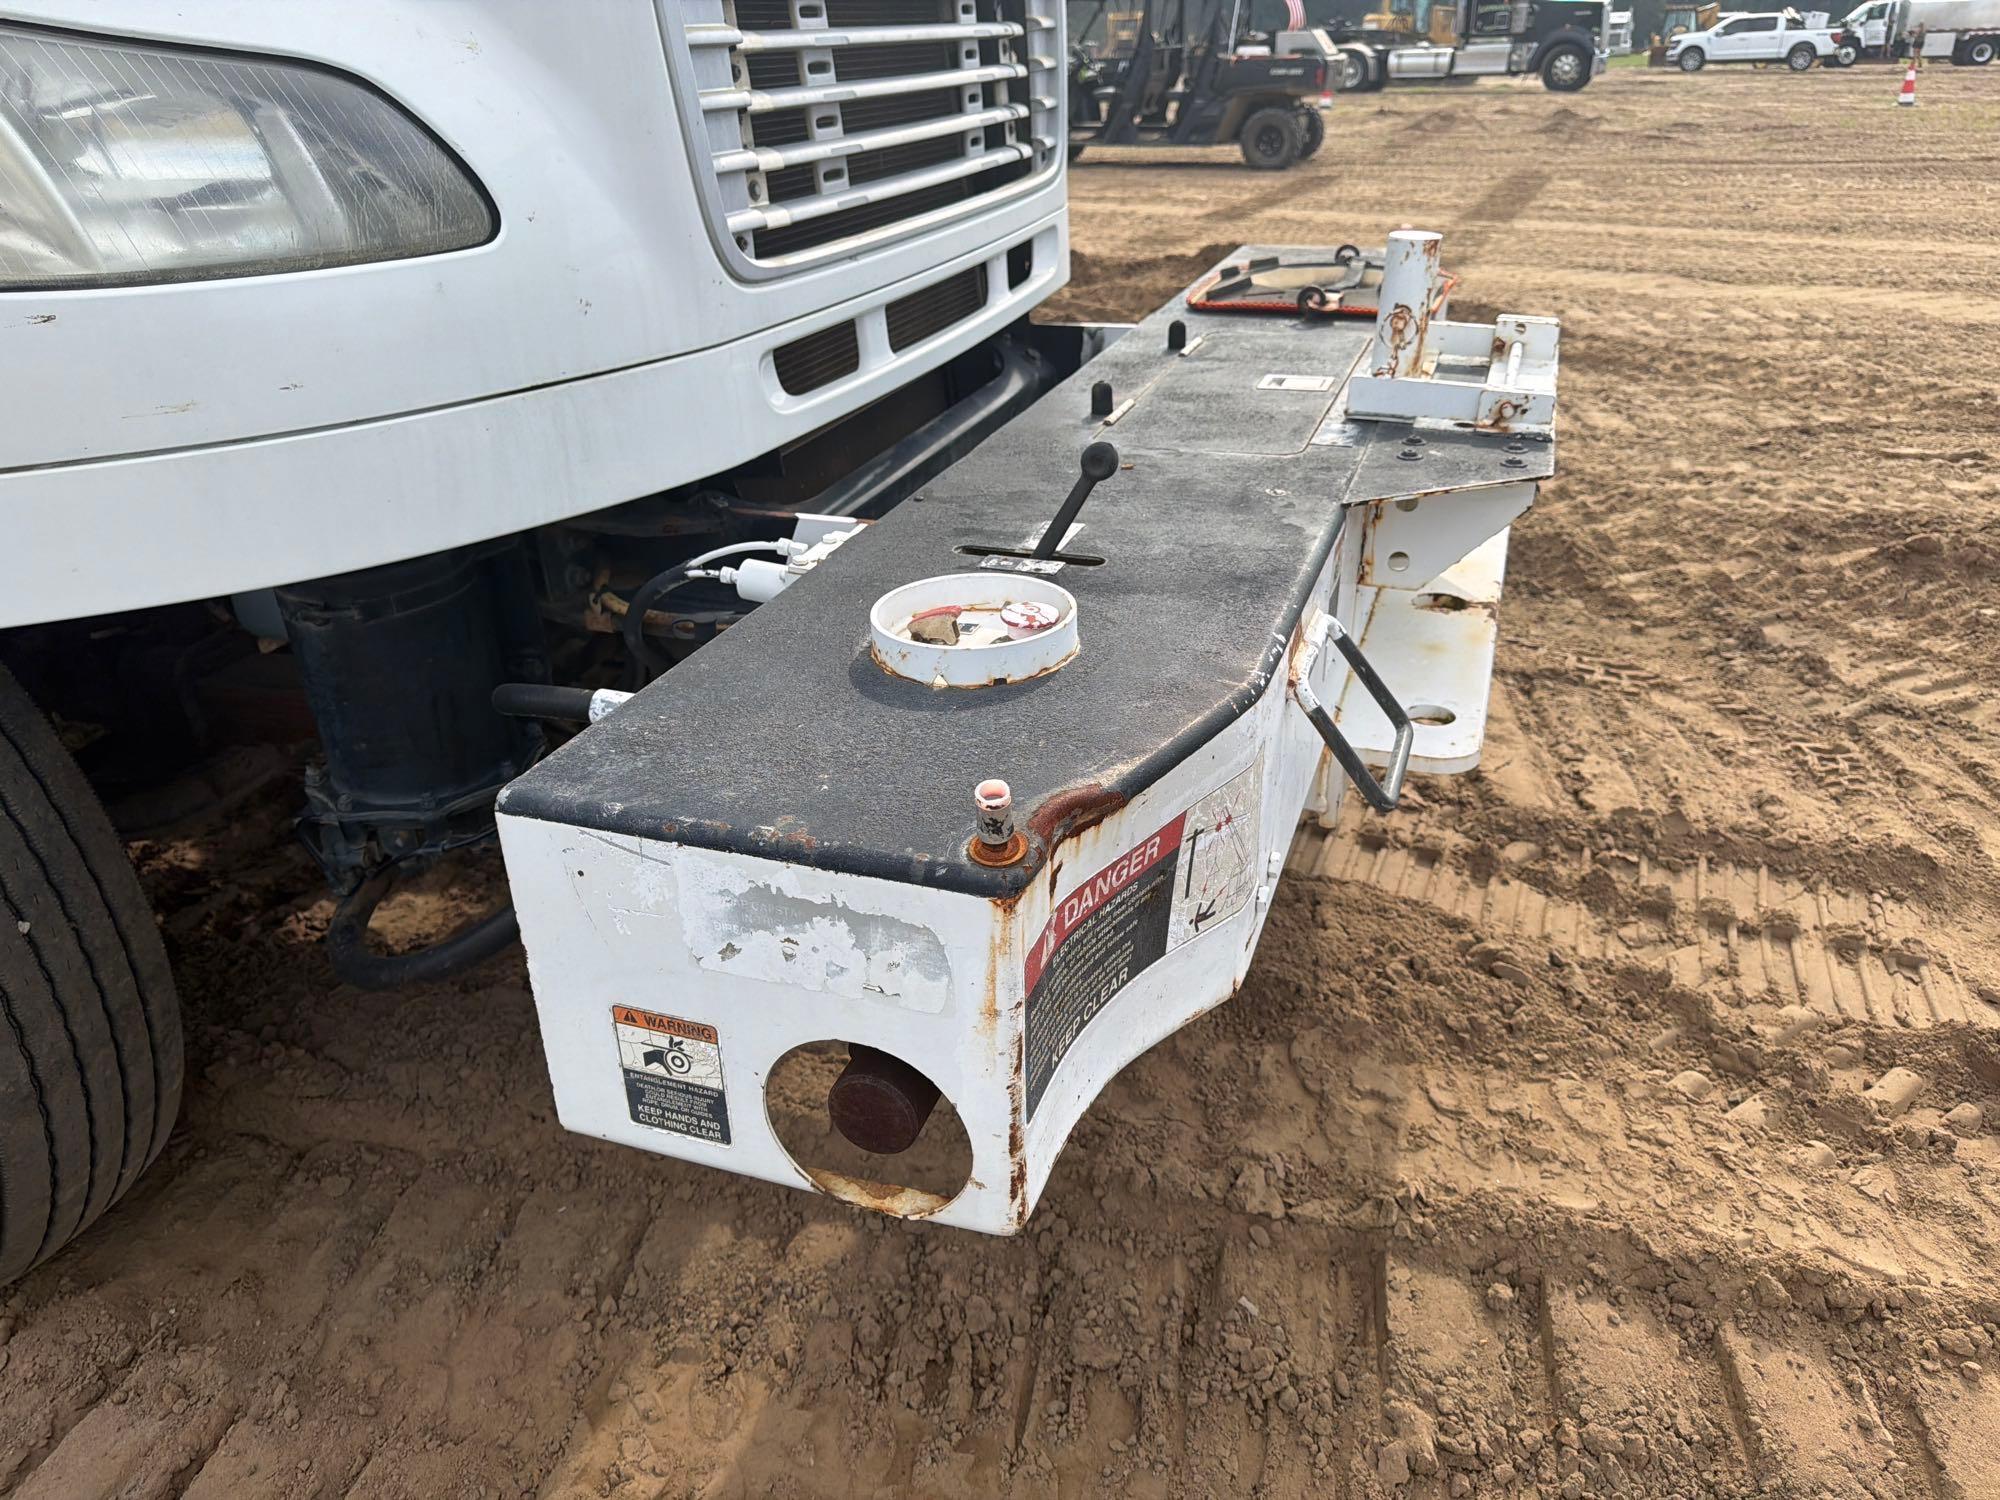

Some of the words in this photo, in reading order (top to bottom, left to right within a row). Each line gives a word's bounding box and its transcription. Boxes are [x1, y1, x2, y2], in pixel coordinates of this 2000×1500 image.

[1064, 834, 1160, 930] DANGER
[1053, 912, 1097, 969] ELECTRICAL
[1099, 879, 1138, 920] HAZARDS
[644, 1015, 711, 1039] WARNING
[1051, 1014, 1080, 1071] KEEP
[1083, 964, 1128, 1024] CLEAR
[630, 1072, 686, 1090] ENTANGLEMENT
[688, 1086, 718, 1098] HAZARD
[638, 1104, 662, 1117] KEEP
[665, 1111, 698, 1125] HANDS
[701, 1120, 720, 1131] AND
[639, 1114, 687, 1131] CLOTHING
[690, 1125, 721, 1139] CLEAR
